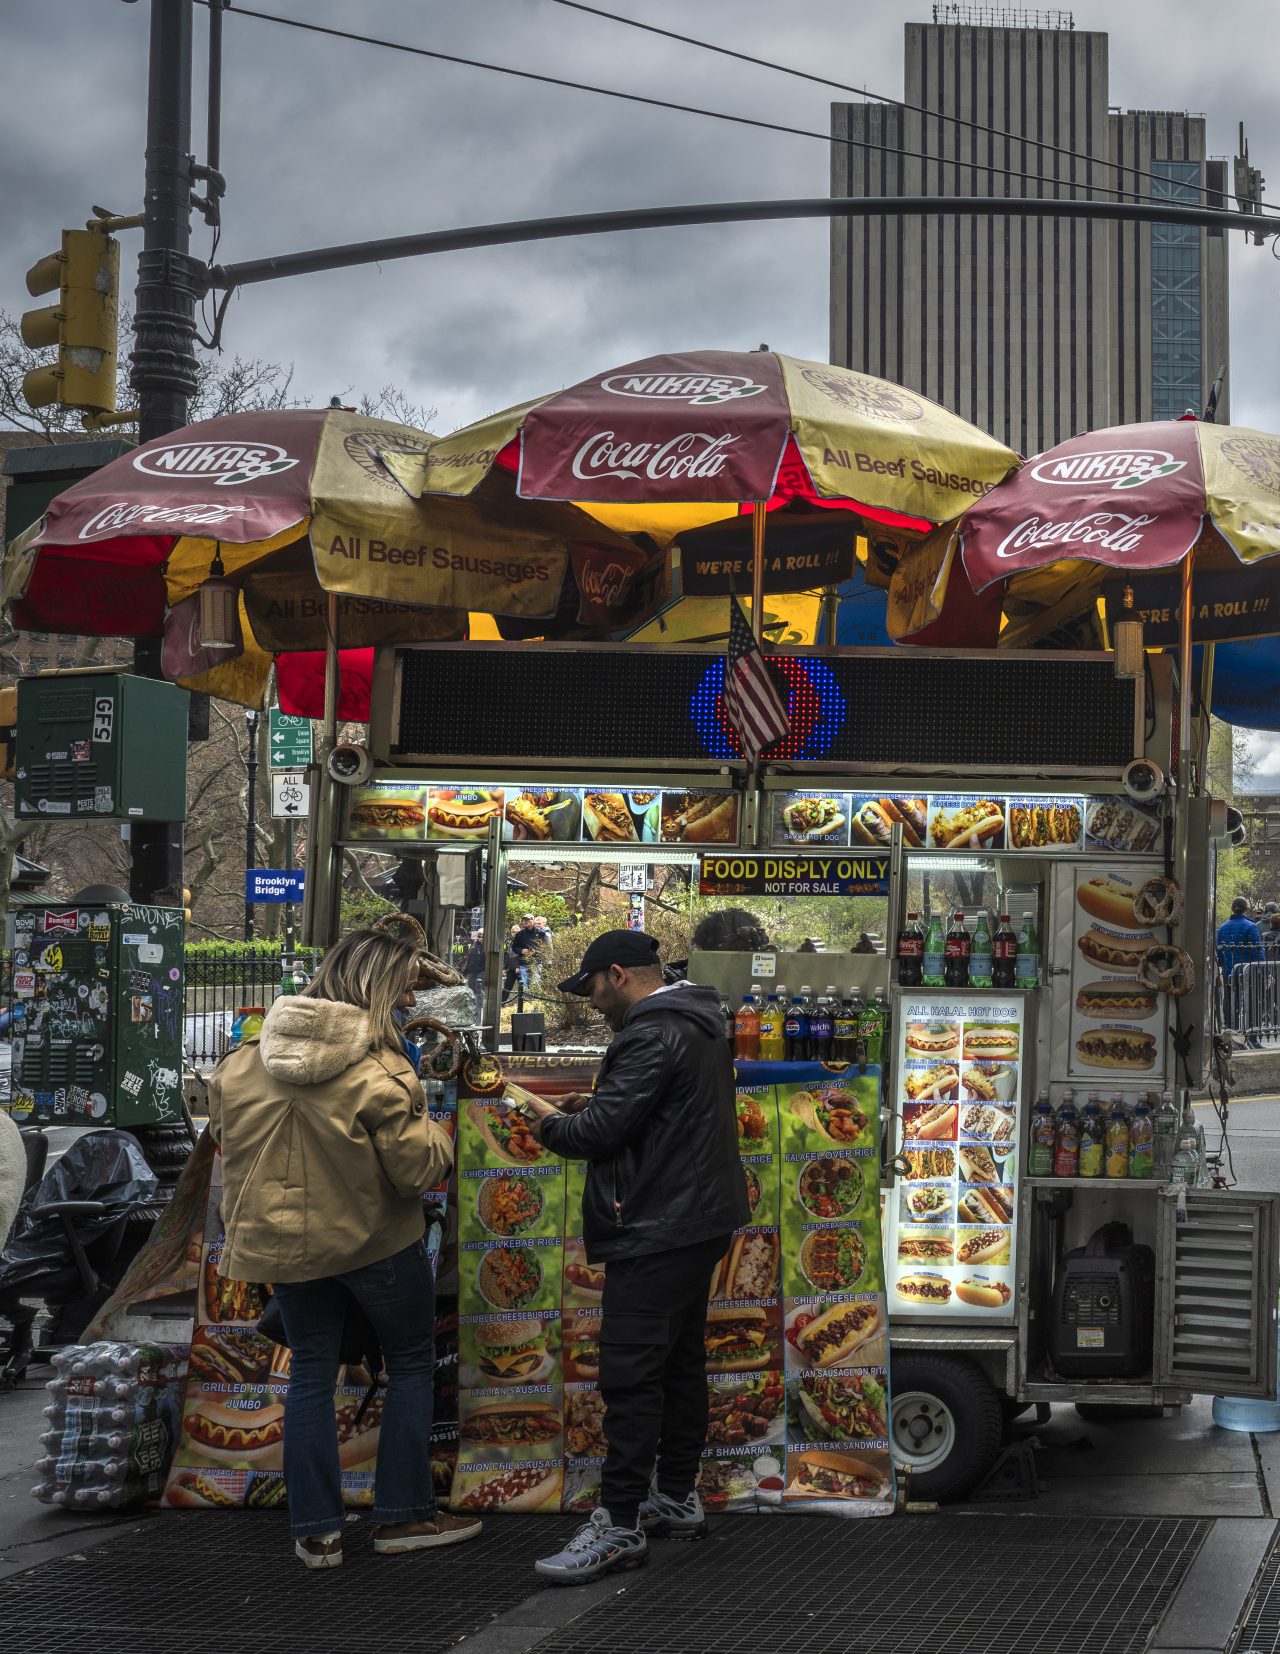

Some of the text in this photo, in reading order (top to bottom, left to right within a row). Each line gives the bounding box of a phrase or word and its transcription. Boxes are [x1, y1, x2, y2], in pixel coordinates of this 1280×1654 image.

[623, 375, 733, 394] NIKAS
[156, 446, 266, 474] NIKAS
[571, 431, 743, 481] Coca-Cola
[823, 448, 905, 478] All Beef
[1053, 452, 1155, 481] NIKAS
[79, 502, 254, 540] Coca-Cola
[996, 512, 1160, 558] Coca-Cola
[329, 535, 550, 584] All Beef Sausages
[696, 554, 821, 576] WE'RE A ROLL
[1201, 601, 1249, 618] A ROLL
[296, 737, 310, 745] Square
[292, 748, 310, 757] Brooklyn
[296, 756, 310, 764] Bridge
[283, 777, 298, 785] ALL
[703, 860, 888, 880] FOOD DISPLY ONLY
[254, 876, 296, 888] Brooklyn
[764, 882, 840, 893] NOT FOR SALE
[254, 886, 286, 896] Bridge
[907, 1005, 1018, 1018] ALL HALAL HOT DOG
[810, 1024, 830, 1032] Welch's
[124, 1071, 144, 1086] MUTZ
[122, 1078, 142, 1093] ZEC
[802, 1081, 831, 1091] Combo
[55, 1088, 65, 1114] KMRC
[428, 1111, 452, 1120] DOG
[750, 1154, 773, 1164] RICE
[785, 1148, 876, 1163] FALAFEL OVER RICE
[462, 1166, 562, 1180] CHICKEN OVER RICE
[746, 1225, 779, 1235] HOT DOG
[802, 1220, 861, 1231] BEEF RICE
[461, 1237, 562, 1251] CHICKEN KEBAB RICE
[712, 1298, 778, 1309] CHEESEBURGER
[793, 1292, 878, 1305] CHILI CHEESE DOG
[496, 1309, 561, 1322] CHEESEBURGER
[727, 1371, 761, 1382] KEBAB
[816, 1367, 888, 1379] SAUSAGE PITA
[201, 1382, 289, 1395] GRILLED HOT DOG
[509, 1384, 553, 1396] SAUSAGE
[226, 1399, 261, 1410] JUMBO
[715, 1445, 772, 1457] SHAWARMA
[787, 1440, 889, 1453] BEEF STEAK SANDWICH
[458, 1458, 564, 1473] ONION SAUSAGE
